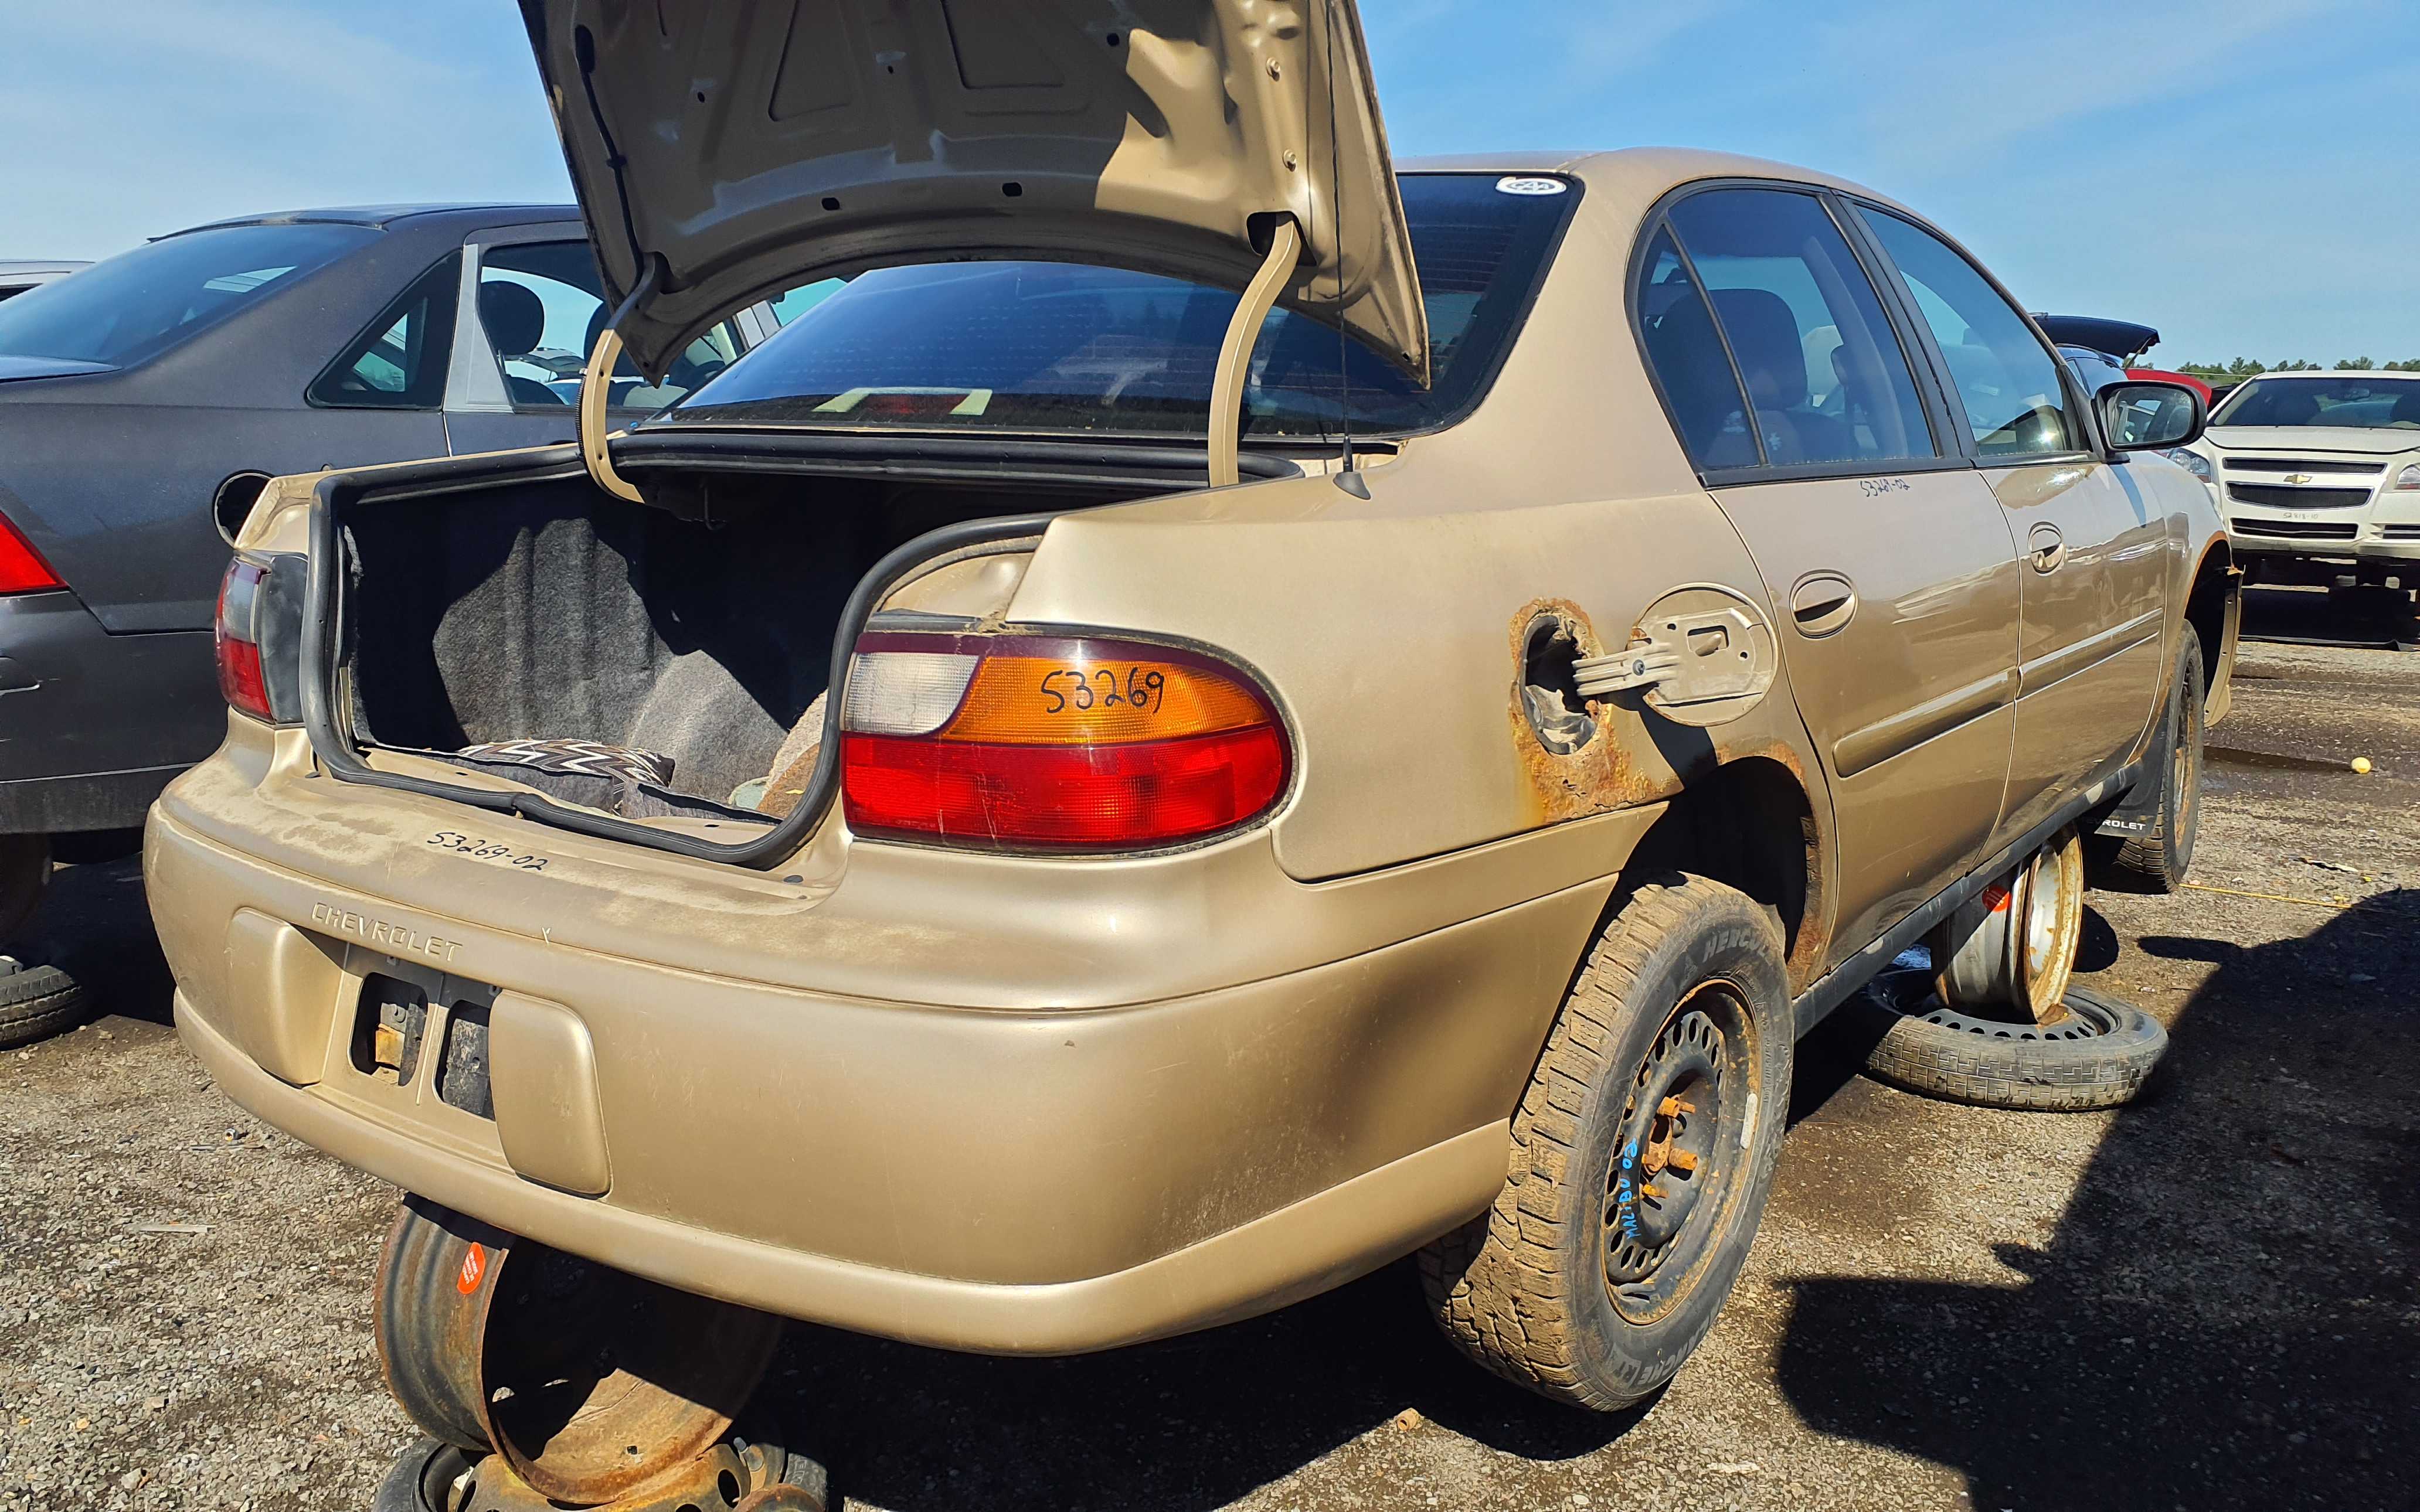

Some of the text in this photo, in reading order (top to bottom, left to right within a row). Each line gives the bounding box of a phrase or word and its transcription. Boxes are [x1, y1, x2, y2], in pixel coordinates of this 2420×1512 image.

[1041, 666, 1165, 714] 53269
[2102, 819, 2147, 830] ROLET
[426, 831, 549, 871] 53269-02
[311, 901, 463, 962] CHEVROLET
